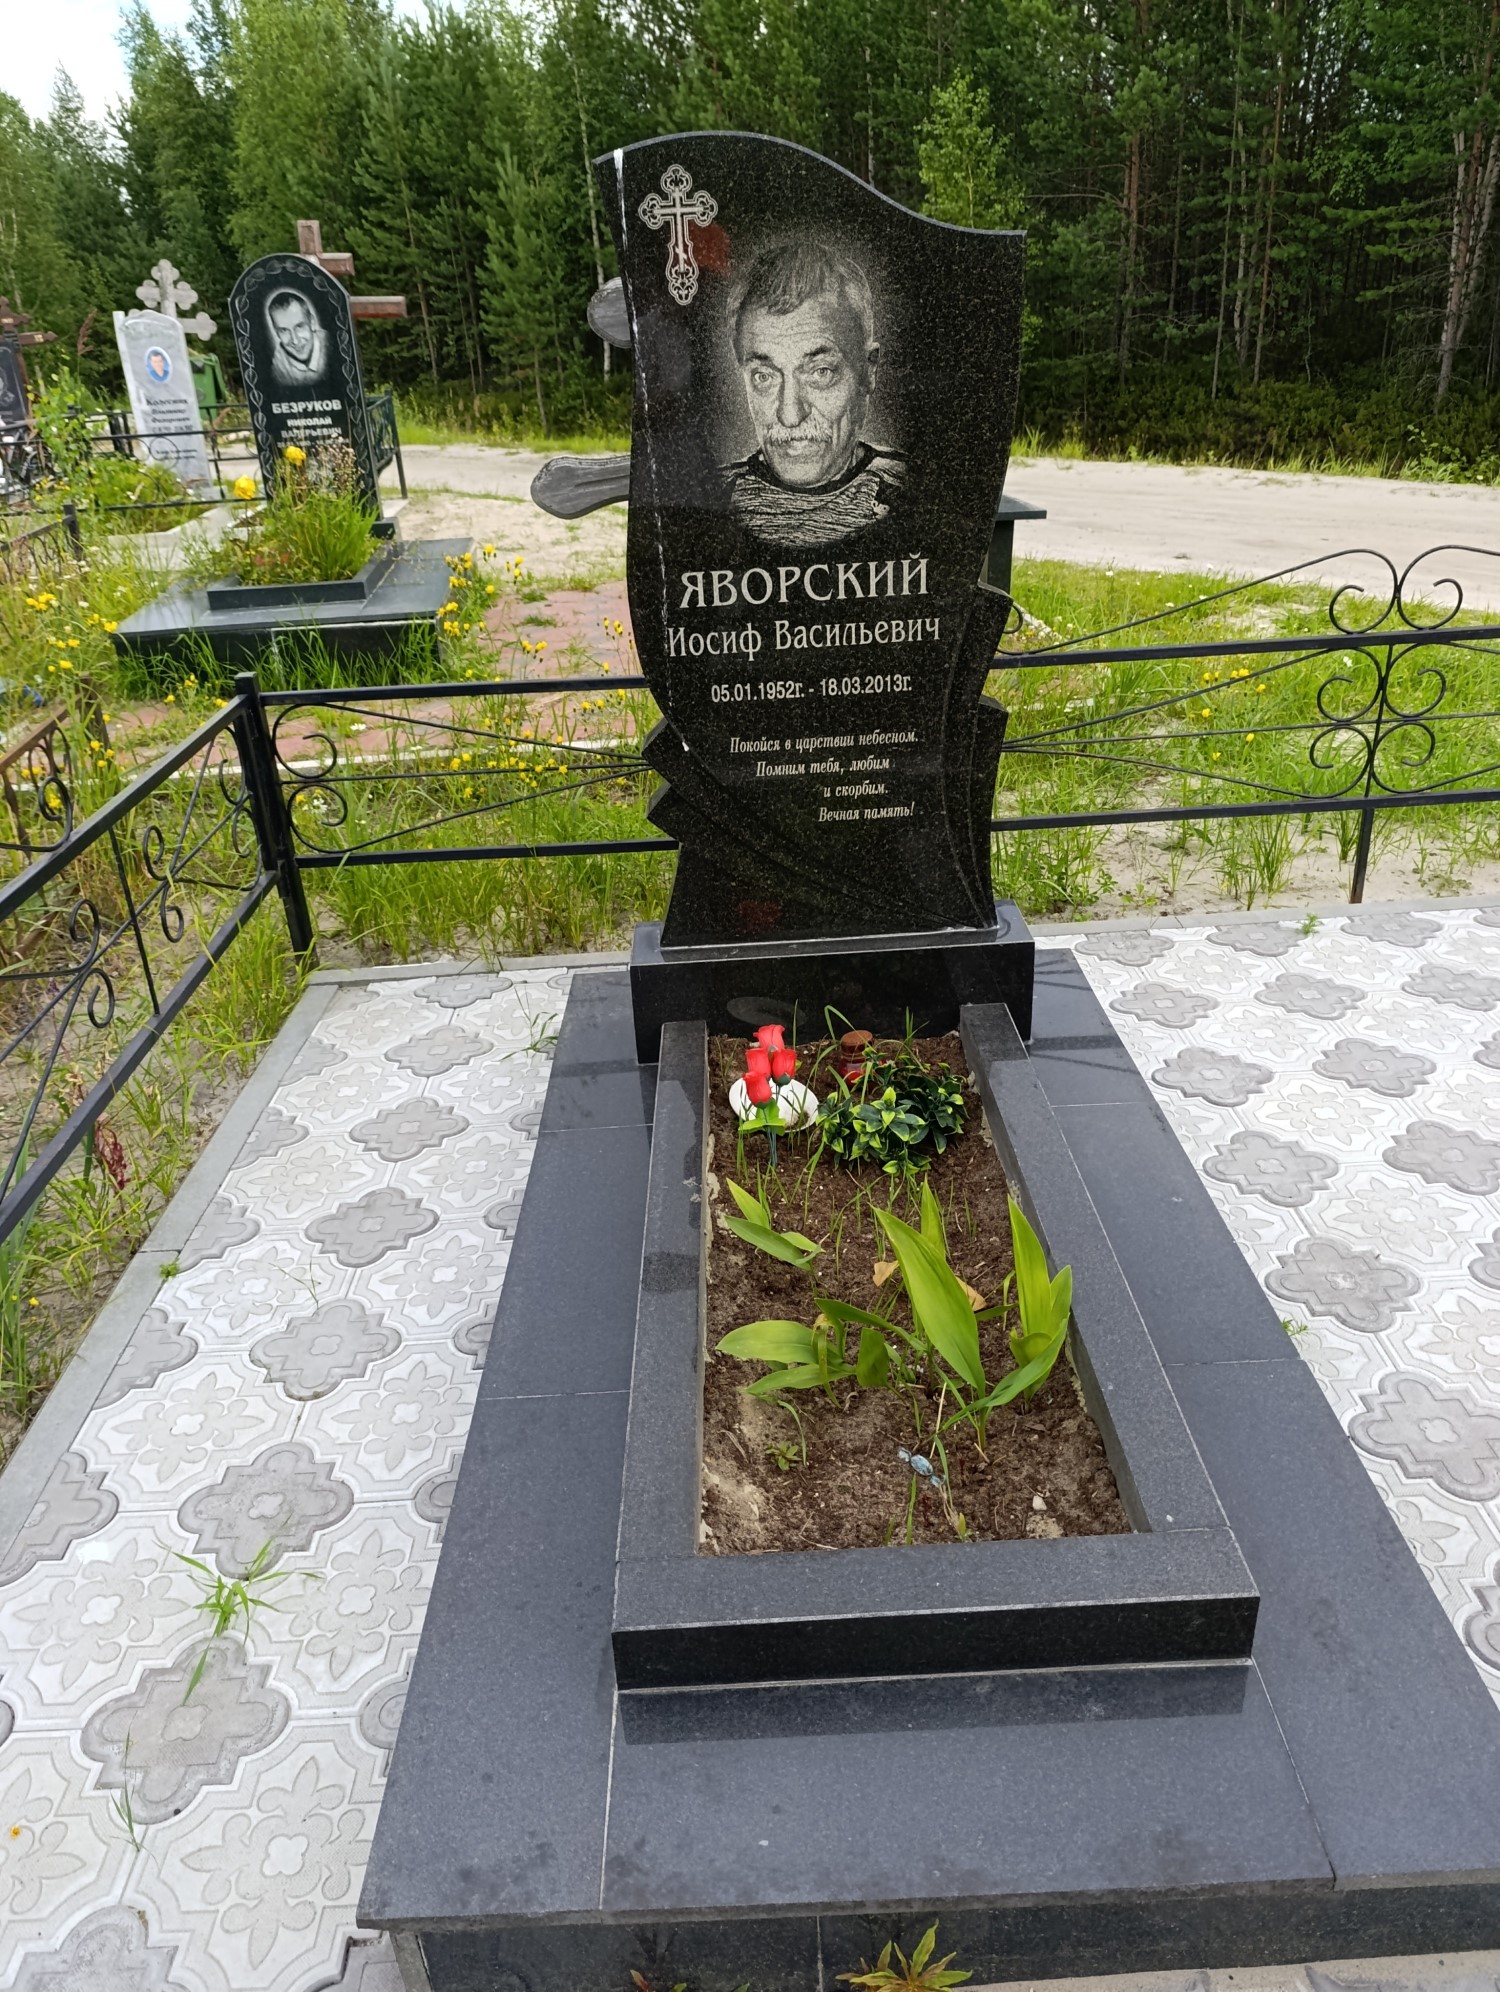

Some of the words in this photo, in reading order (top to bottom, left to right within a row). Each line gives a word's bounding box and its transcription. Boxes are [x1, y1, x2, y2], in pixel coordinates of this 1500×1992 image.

[271, 399, 342, 414] БЕЗРУКОВ
[286, 415, 332, 427] НИКОЛАЙ
[679, 551, 929, 608] ЯВОРСКИЙ
[667, 622, 762, 661] Иосиф
[775, 618, 940, 650] Васильевич
[711, 681, 805, 702] 05.01.1952г.
[820, 674, 912, 697] 18.03.2013г.
[730, 736, 780, 753] Покойся
[785, 741, 791, 750] в
[796, 735, 854, 753] царствии
[858, 729, 919, 746] небесном.
[756, 761, 805, 777] Помним
[809, 757, 845, 775] тебя,
[849, 755, 890, 771] любим
[823, 787, 831, 798] и
[835, 780, 889, 799] скорбим.
[818, 807, 860, 822] Вечная
[864, 801, 916, 820] память!
